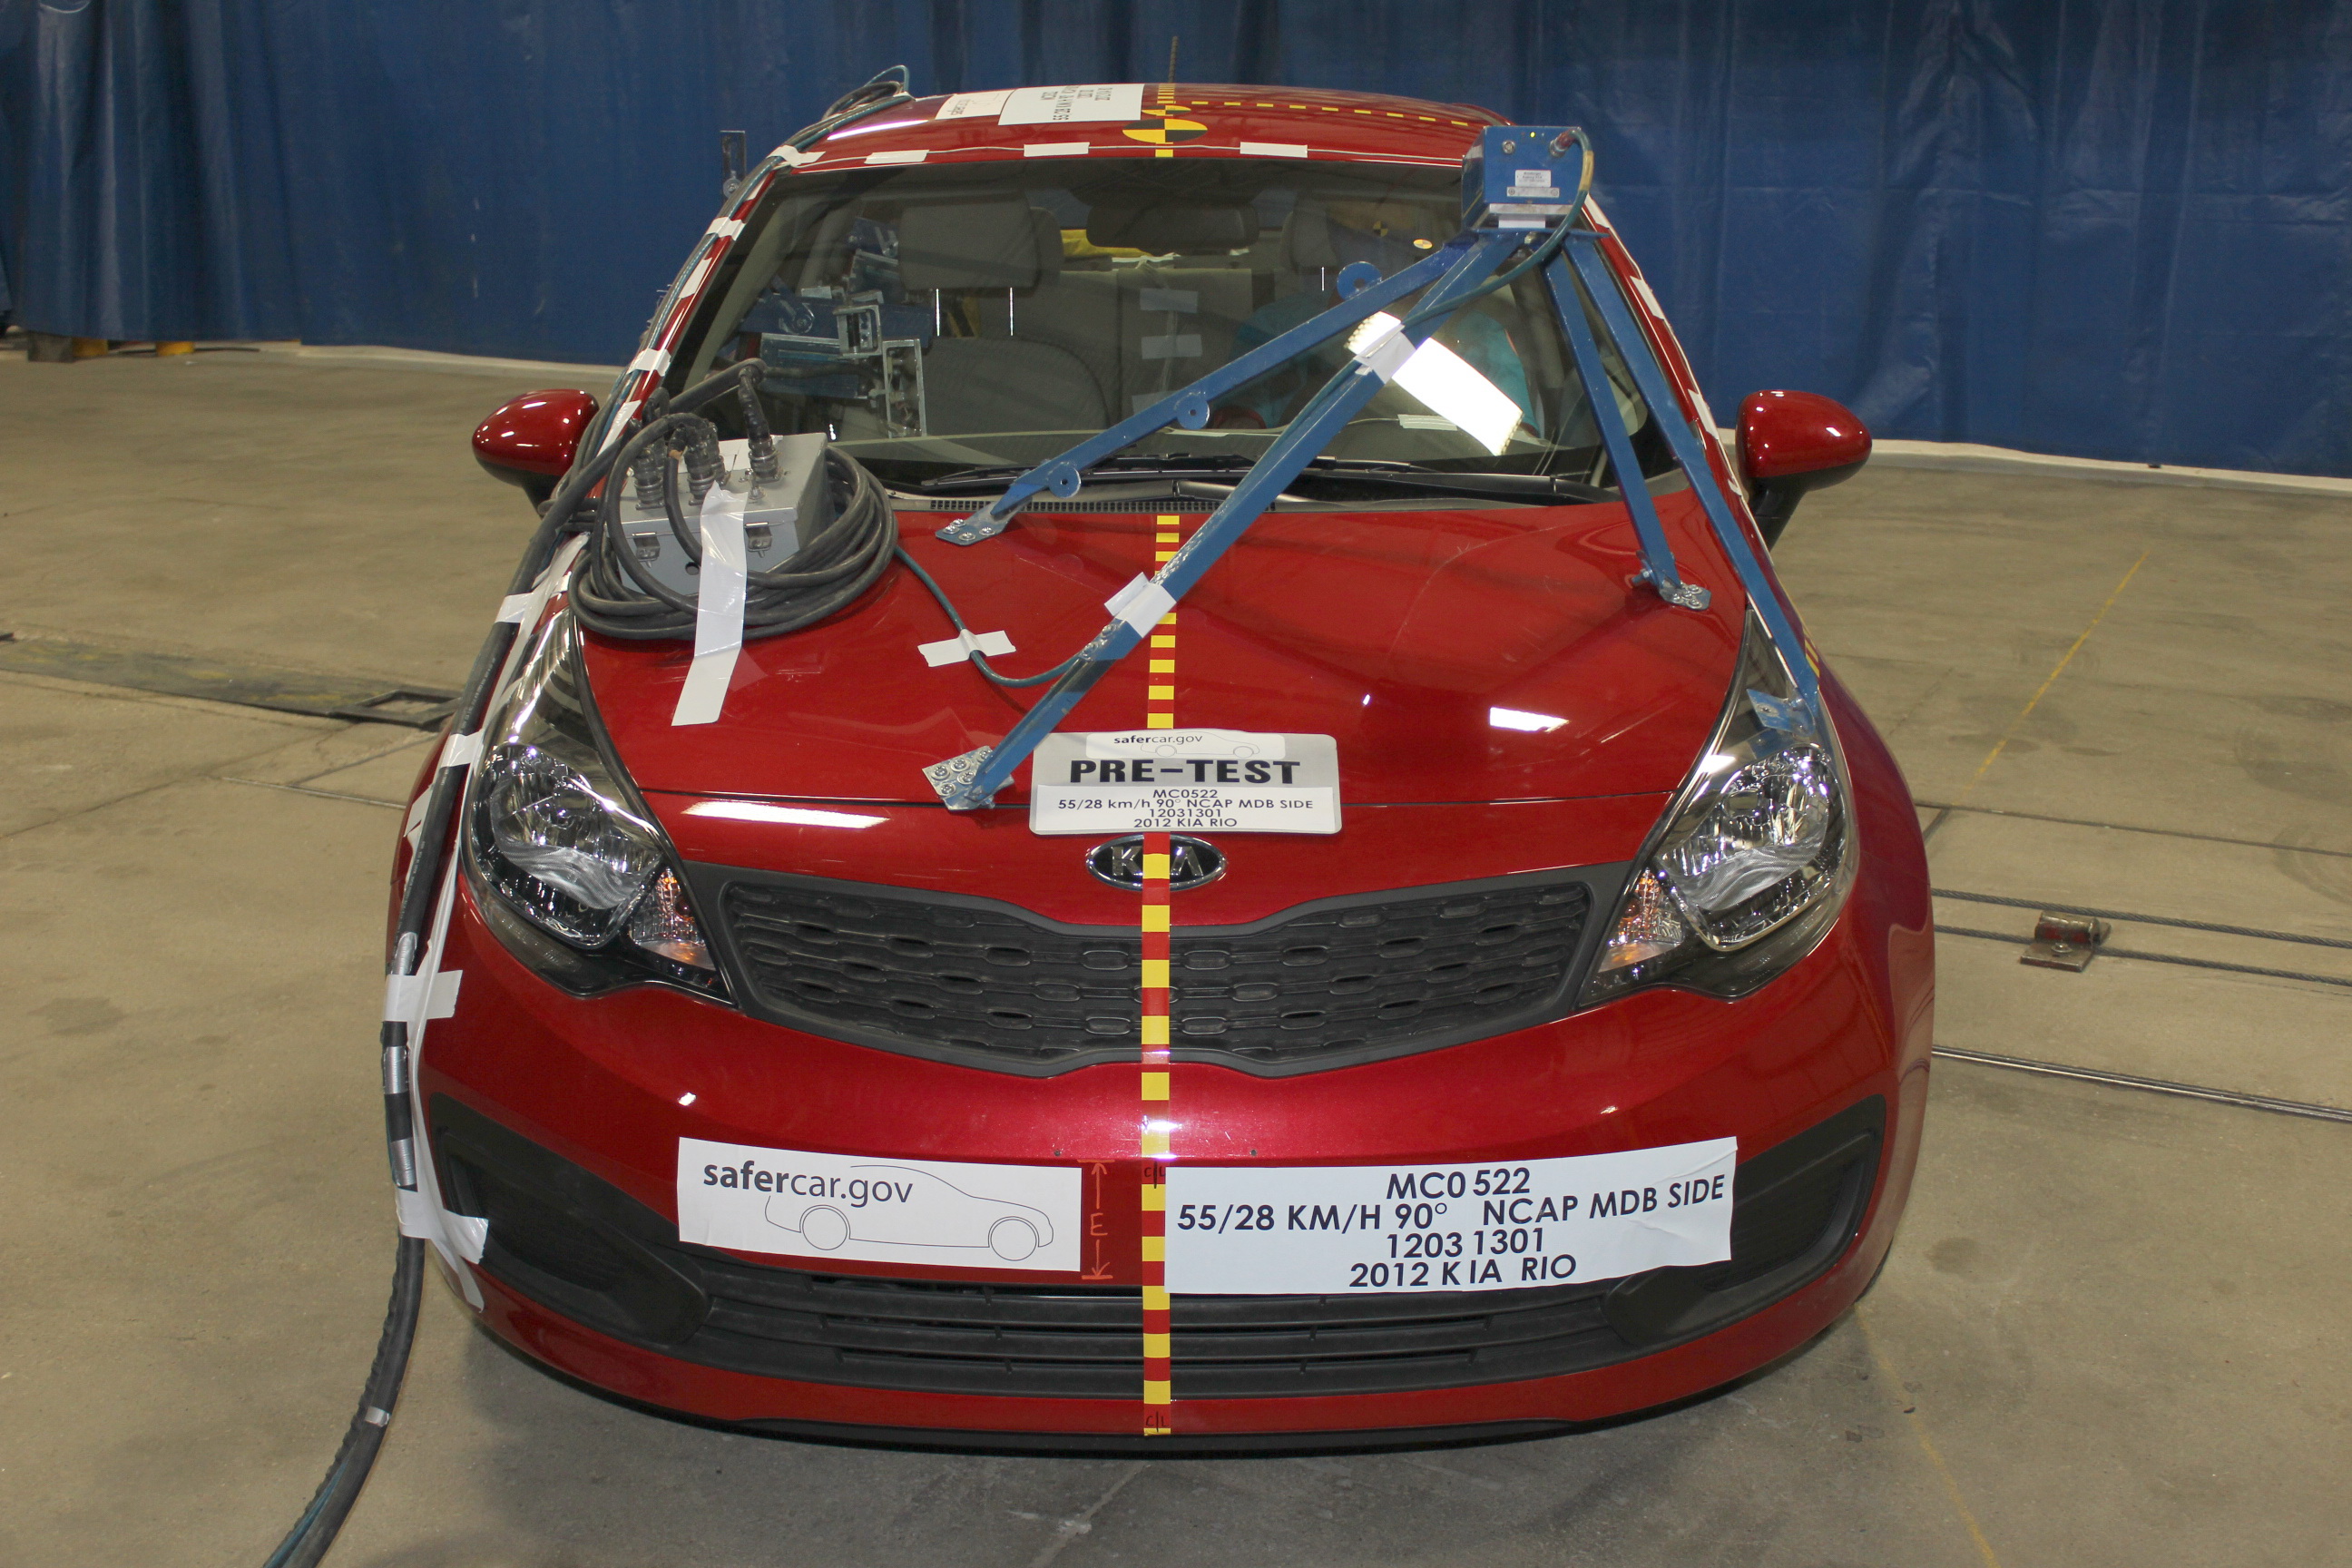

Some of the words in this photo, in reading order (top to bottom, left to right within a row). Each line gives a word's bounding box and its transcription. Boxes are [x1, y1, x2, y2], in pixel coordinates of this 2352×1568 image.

[1113, 735, 1203, 745] safercar.gov
[1070, 759, 1301, 784] PRE-TEST
[1058, 799, 1102, 810] 55/28
[1108, 799, 1151, 809] km/h
[1187, 799, 1233, 808] NCAP
[1239, 799, 1275, 808] MDB
[1279, 799, 1313, 808] SIDE
[1152, 789, 1218, 799] MC0522
[1133, 818, 1171, 828] 2012
[1177, 818, 1203, 828] KIA
[1210, 818, 1238, 827] RIO
[1149, 808, 1221, 818] 12031301
[1112, 846, 1203, 876] KA
[703, 1160, 913, 1209] safercar.gov
[1177, 1204, 1275, 1234] 55/28
[1288, 1204, 1381, 1235] KM/H
[1483, 1195, 1579, 1226] NCAP
[1589, 1187, 1658, 1220] MDB
[1667, 1173, 1725, 1209] SIDE
[1090, 1212, 1108, 1236] E
[1349, 1261, 1429, 1288] 2012
[1442, 1259, 1503, 1286] KIA
[1521, 1253, 1577, 1281] RIO
